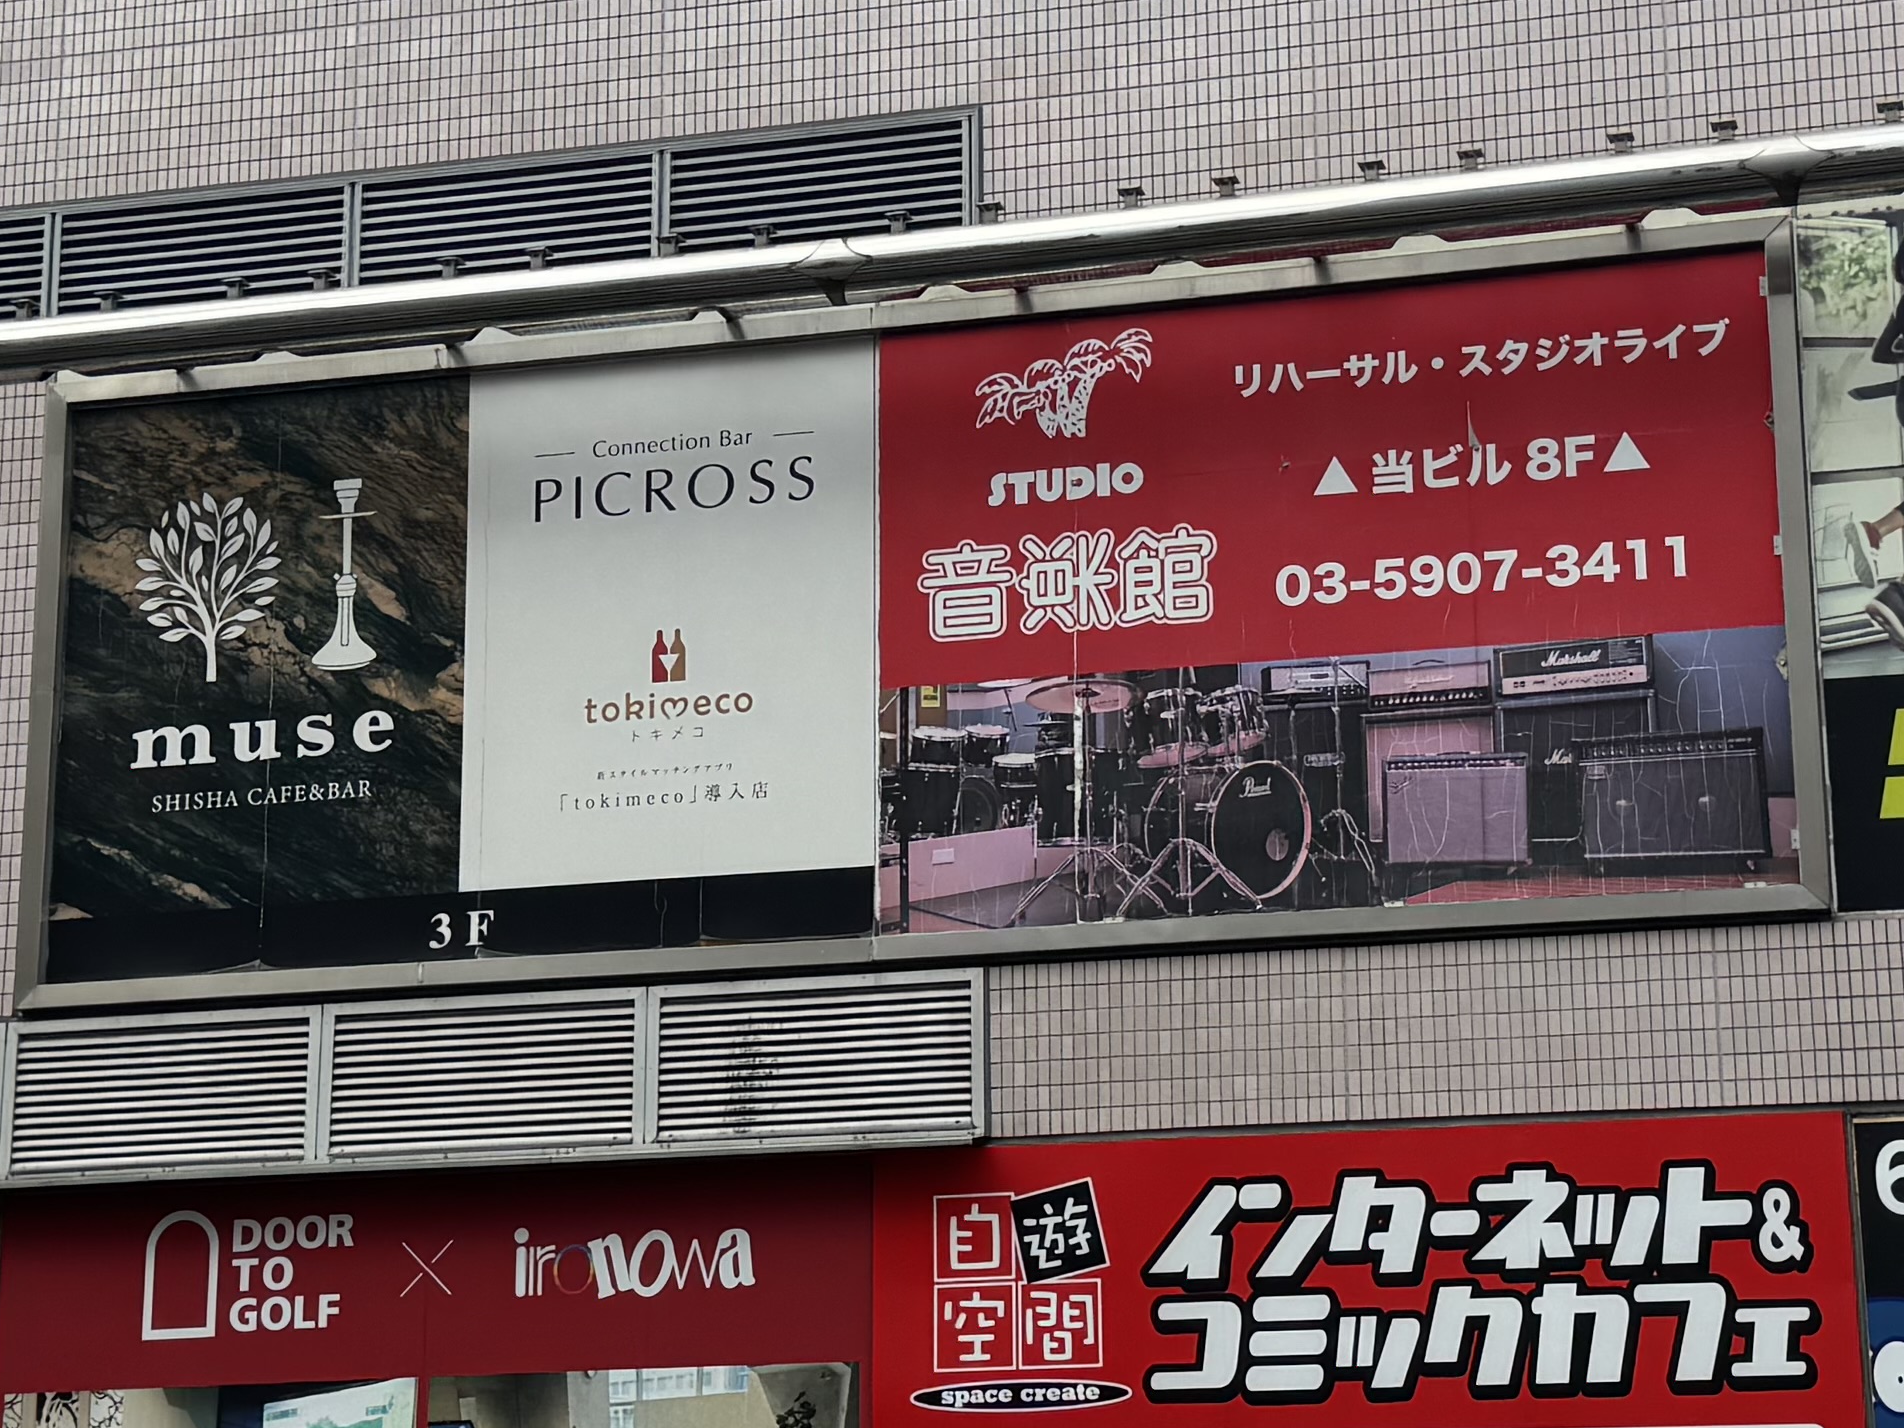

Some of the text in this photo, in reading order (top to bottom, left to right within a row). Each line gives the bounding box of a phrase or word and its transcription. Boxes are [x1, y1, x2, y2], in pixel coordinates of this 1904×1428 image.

[1234, 317, 1730, 398] リハーサル・スタジオライブ
[592, 427, 753, 458] Connection Bar
[533, 456, 816, 523] PICROSS
[988, 462, 1144, 507] STUDIO
[1274, 534, 1688, 608] 03-5907-3411
[130, 704, 395, 772] muse
[632, 726, 704, 742] トキメコ
[151, 779, 372, 814] SHISHA CAFE&BAR
[233, 1213, 354, 1253] DOOR
[232, 1256, 296, 1292] TO
[513, 1226, 756, 1300] ironowa
[228, 1293, 341, 1333] GOLF
[1151, 1282, 1815, 1394] コミックカフェ
[941, 1384, 1100, 1408] space create
